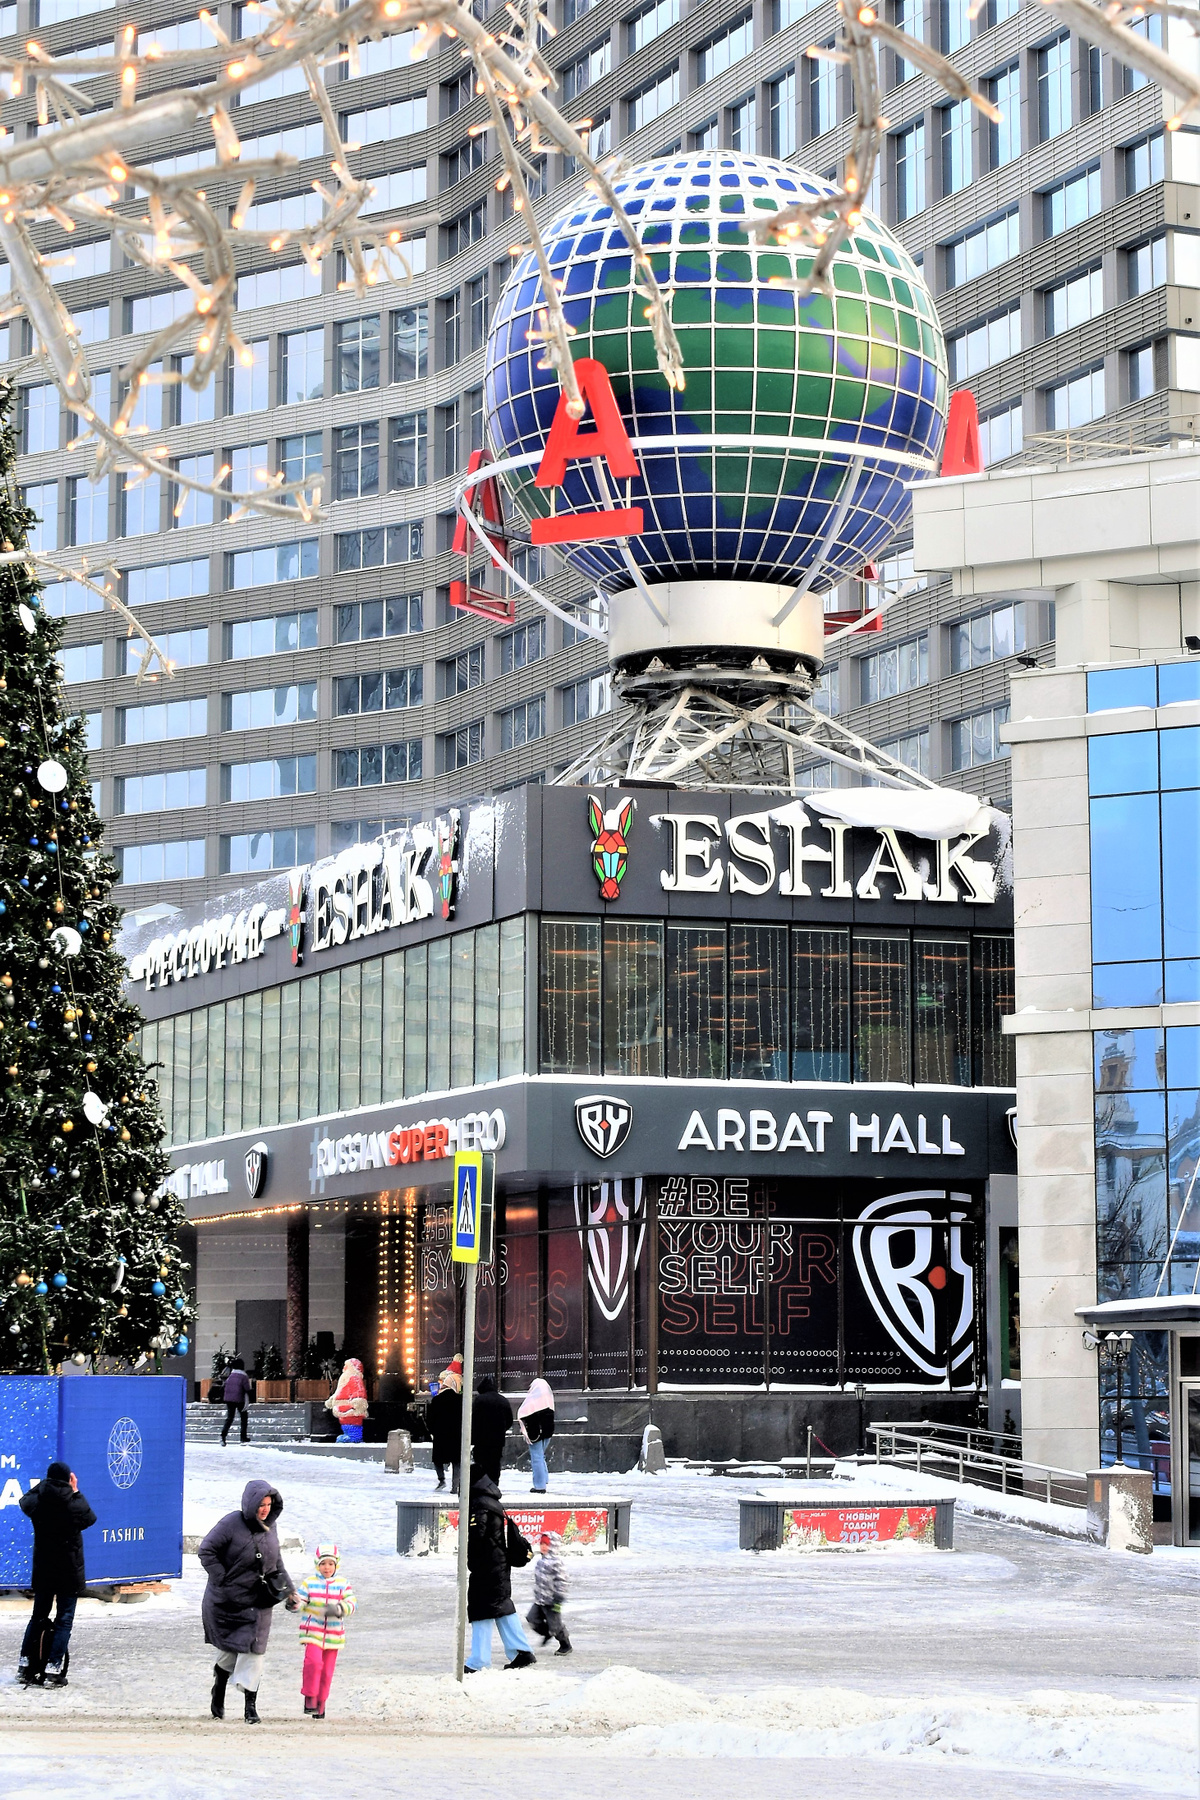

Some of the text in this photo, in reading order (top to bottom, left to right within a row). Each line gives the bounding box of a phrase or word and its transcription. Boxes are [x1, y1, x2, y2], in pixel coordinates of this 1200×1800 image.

[660, 812, 996, 903] ESHAK
[311, 845, 434, 952] ESHAK
[678, 1109, 965, 1155] ARBAT HALL
[190, 1159, 229, 1197] HALL
[658, 1177, 750, 1217] #BE
[659, 1221, 794, 1256] YOUR
[658, 1255, 774, 1295] SELF
[662, 1284, 812, 1335] SELF
[102, 1527, 145, 1543] TASHIR
[838, 1512, 880, 1521] С НОВЫМ
[843, 1522, 877, 1530] ГОДОМ!
[840, 1530, 880, 1544] 2022
